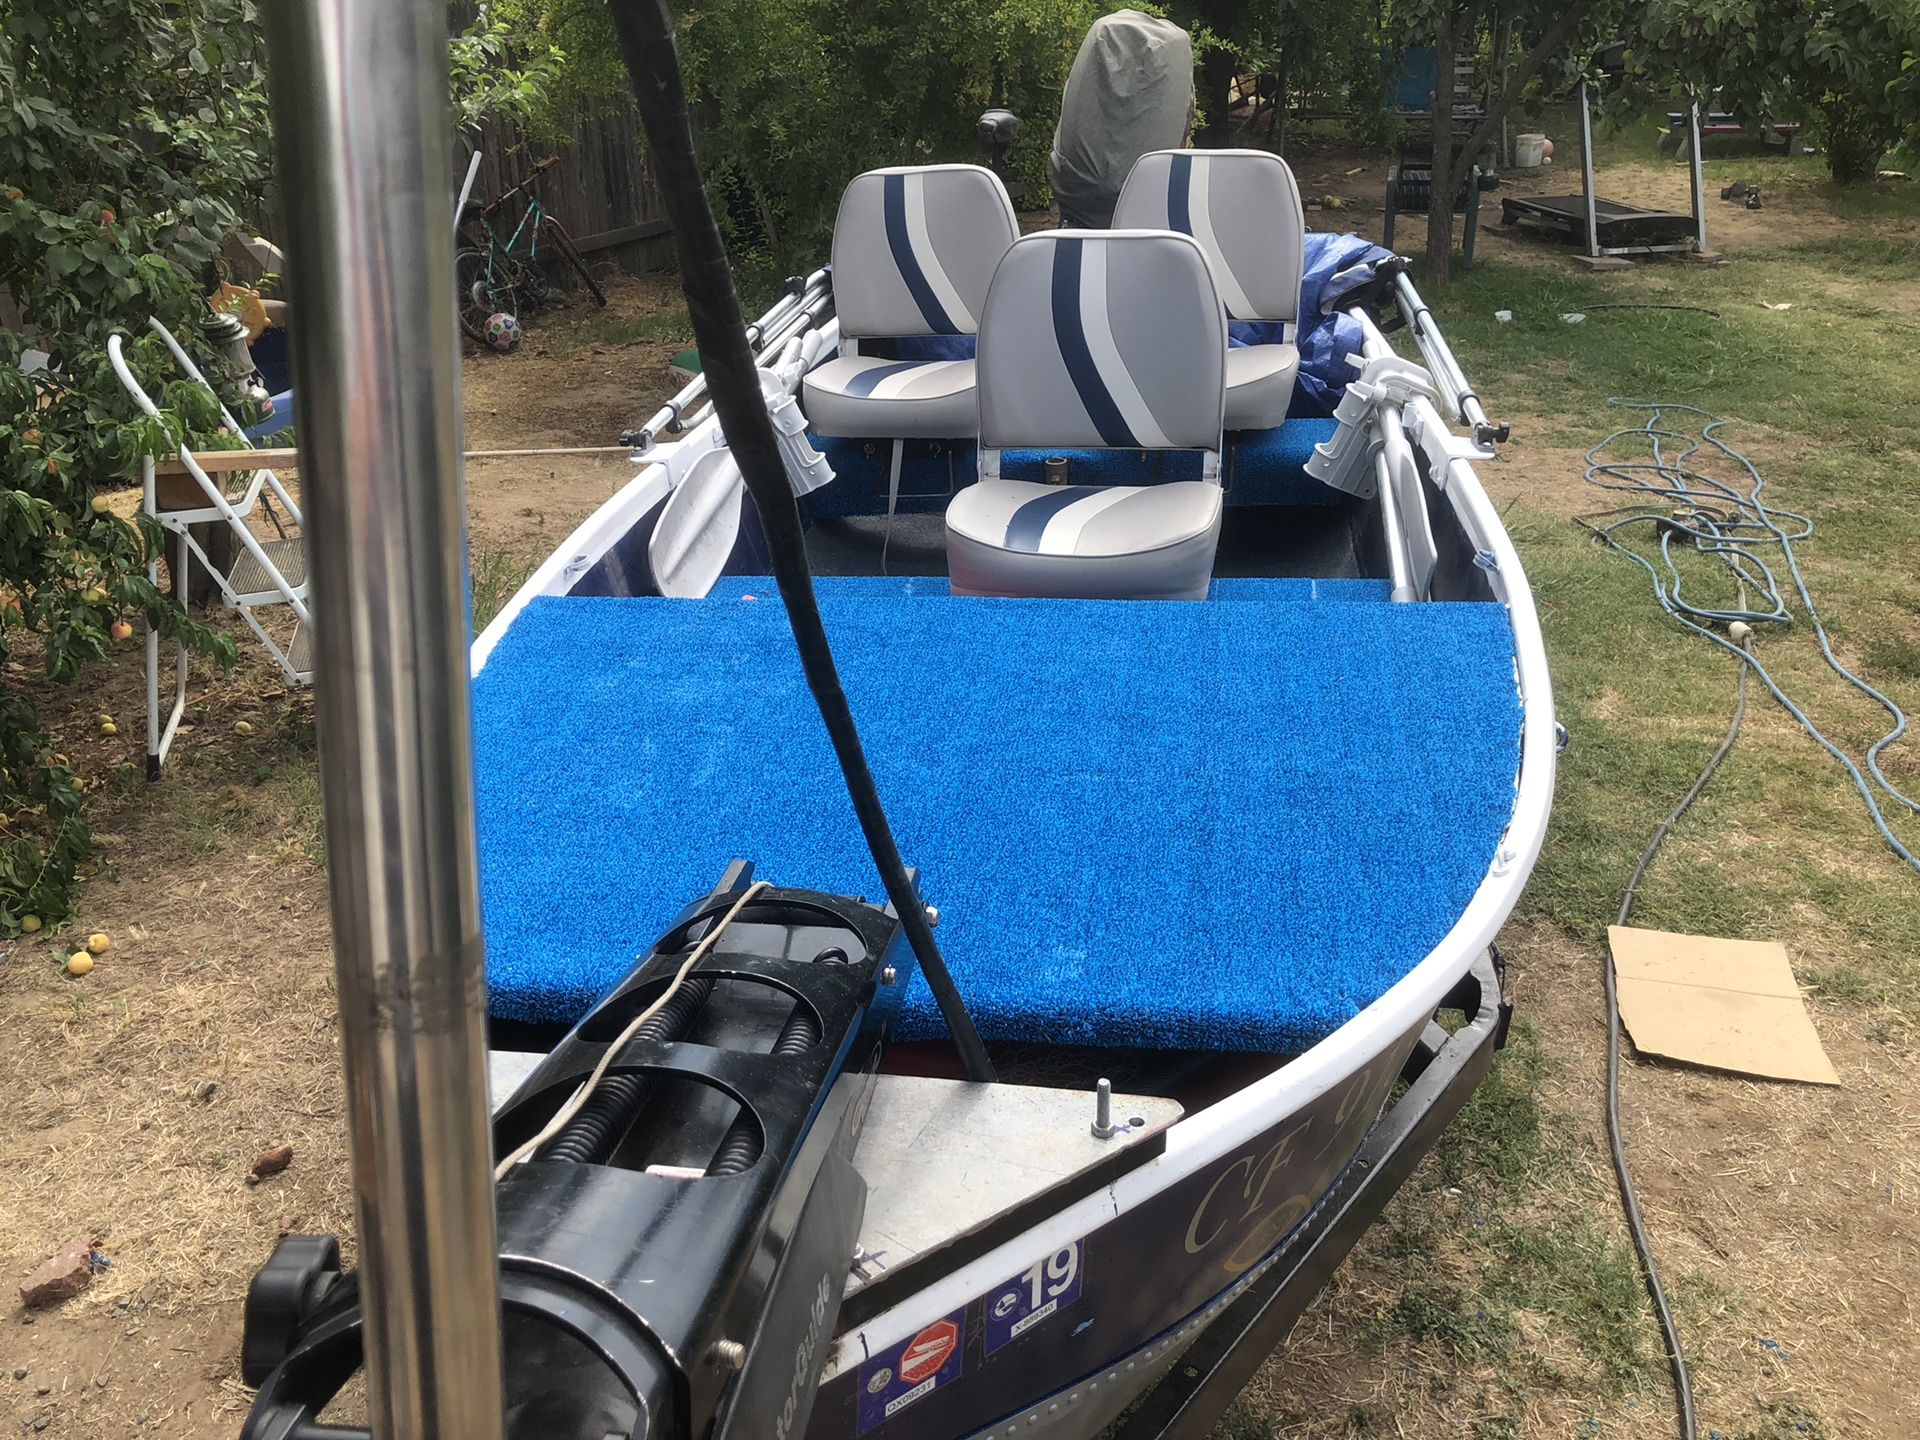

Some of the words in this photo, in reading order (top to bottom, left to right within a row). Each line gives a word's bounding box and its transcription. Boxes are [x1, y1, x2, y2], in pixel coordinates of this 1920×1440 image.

[1184, 1115, 1314, 1254] CF
[1021, 1241, 1078, 1310] 19
[887, 1381, 932, 1413] QX09231
